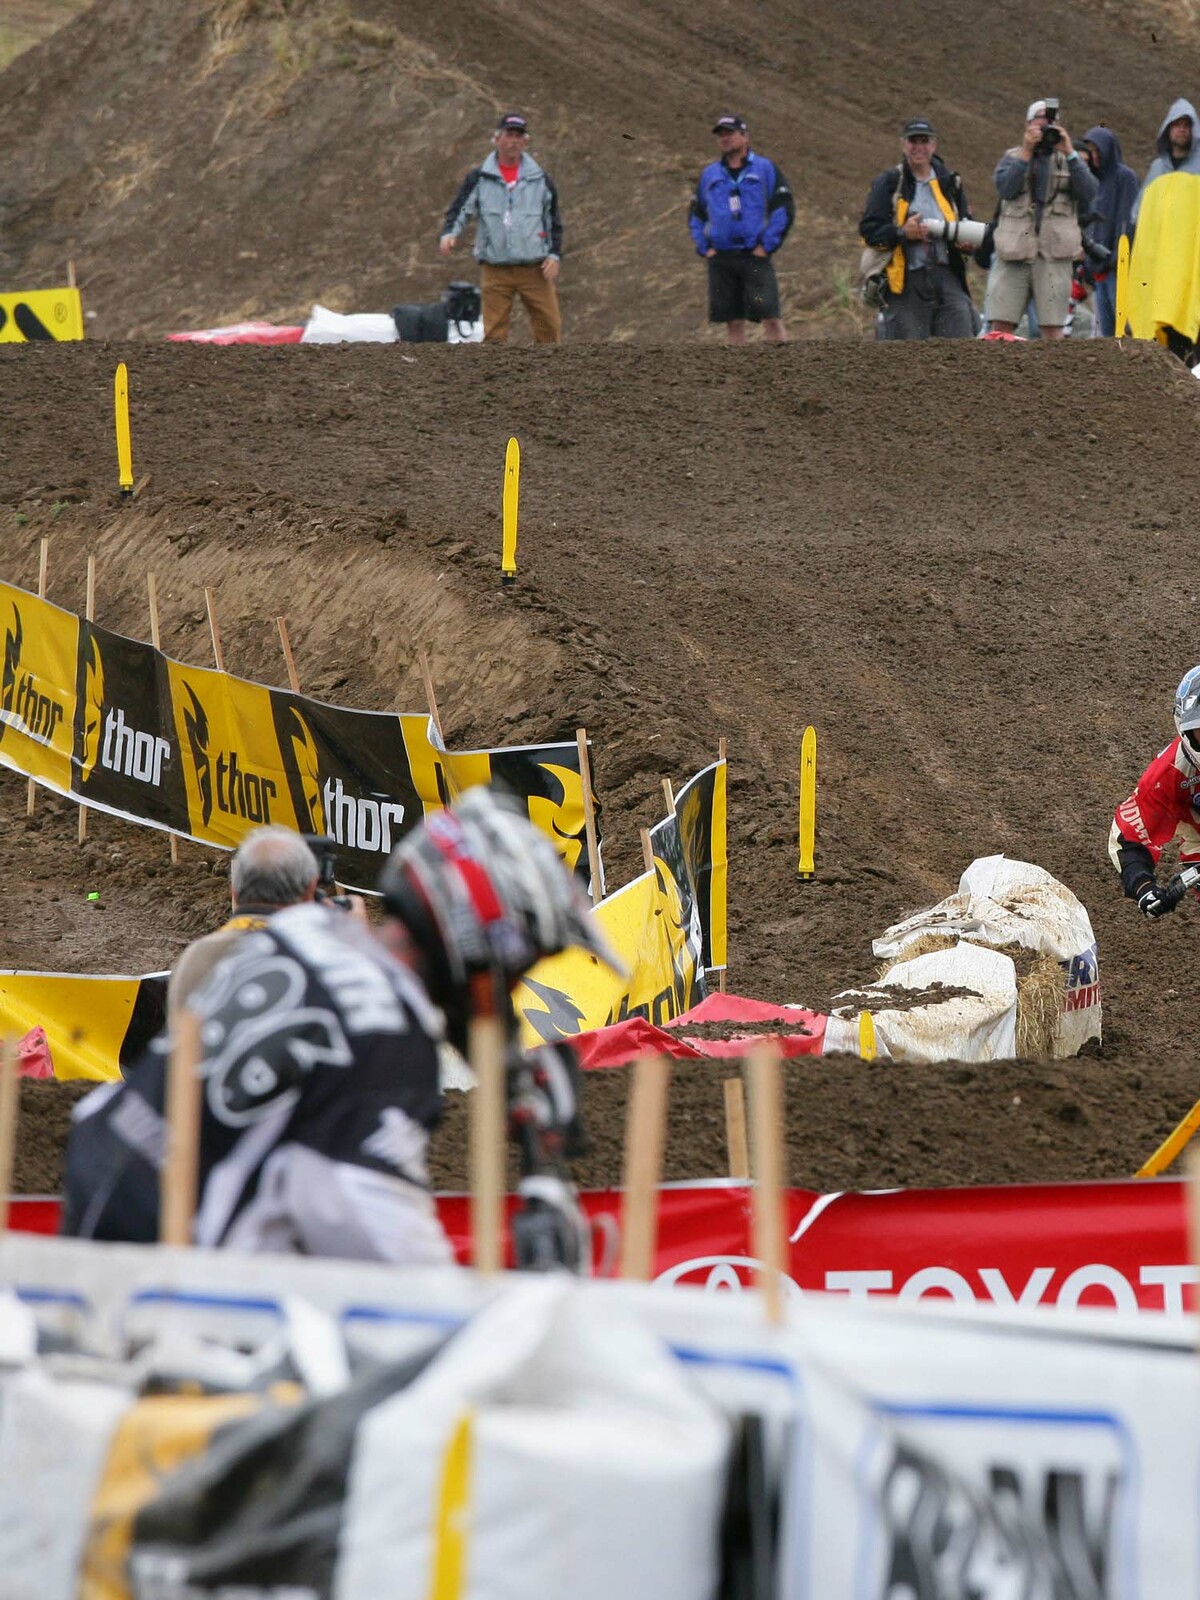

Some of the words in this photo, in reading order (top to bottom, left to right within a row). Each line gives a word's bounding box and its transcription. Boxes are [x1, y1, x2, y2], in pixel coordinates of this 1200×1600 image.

[16, 672, 64, 743] thor
[101, 707, 171, 787] thor
[216, 750, 277, 826] thor
[323, 777, 405, 854] thor
